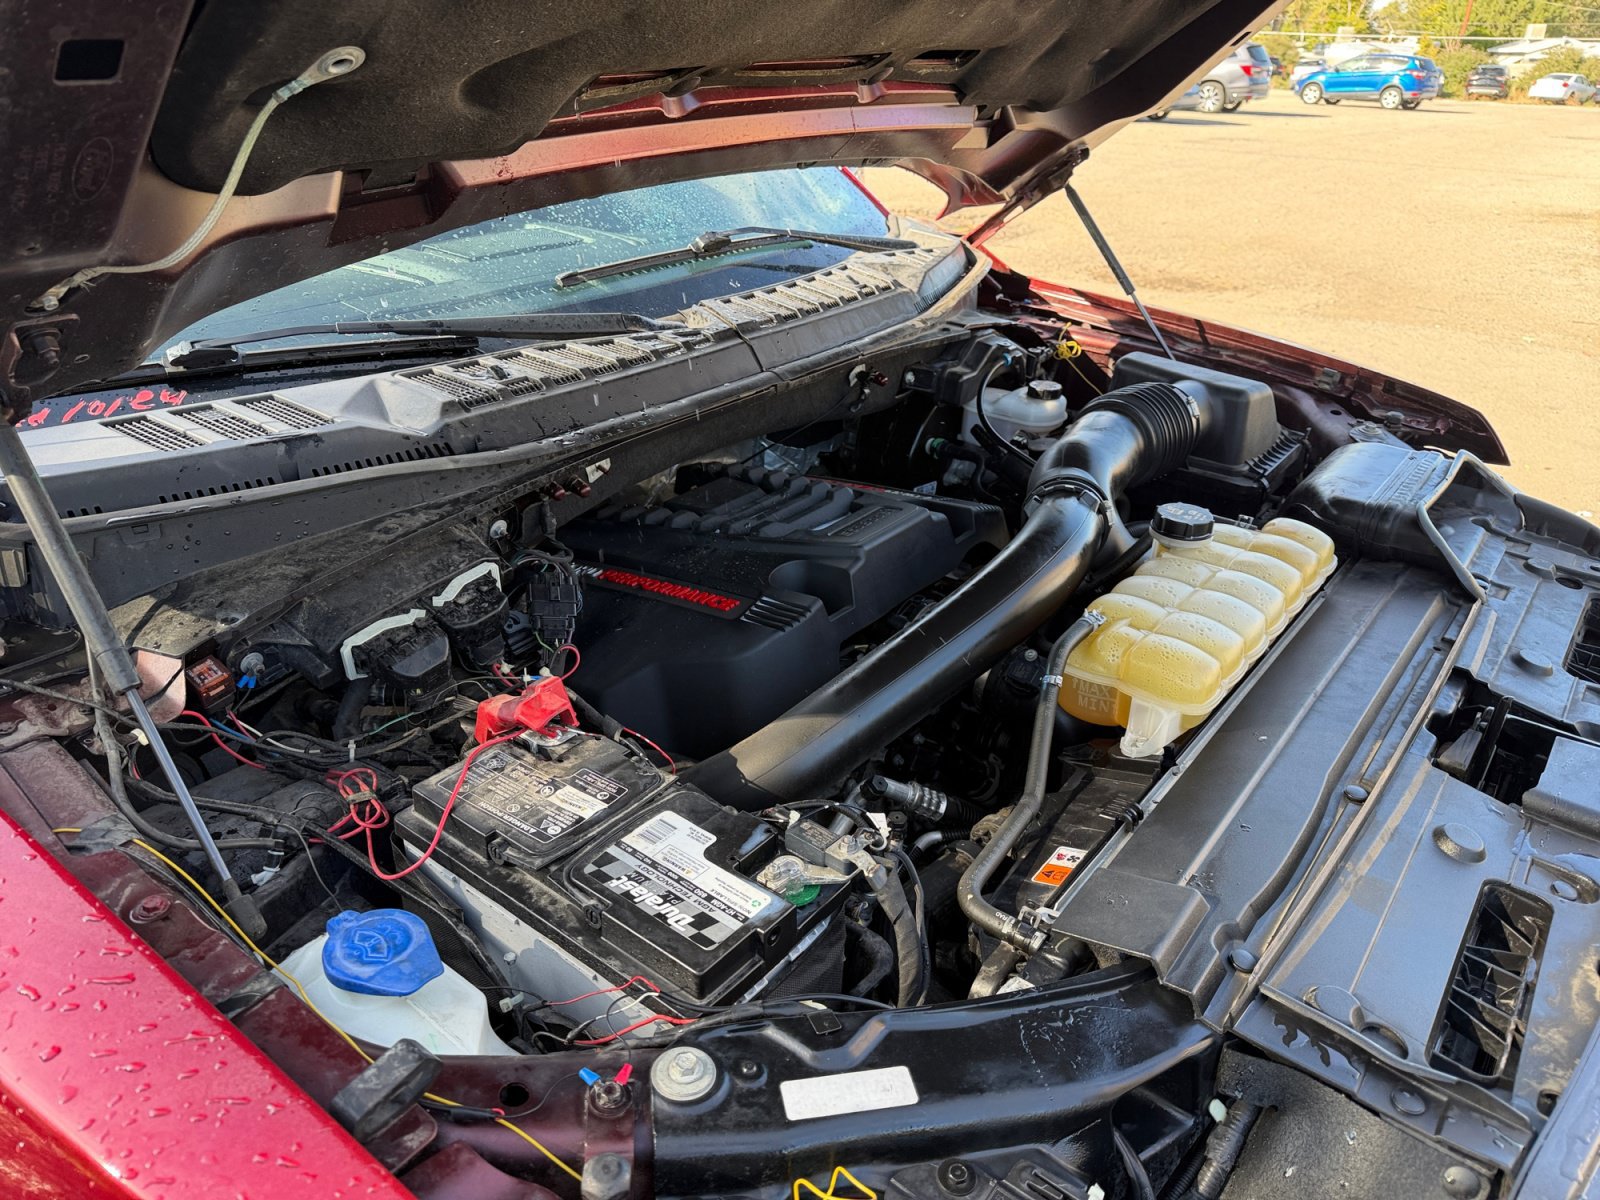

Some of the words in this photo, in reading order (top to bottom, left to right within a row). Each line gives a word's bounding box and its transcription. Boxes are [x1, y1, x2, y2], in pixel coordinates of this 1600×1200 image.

[598, 569, 741, 611] PERFORMANCE
[1078, 694, 1110, 713] MIN
[1079, 680, 1110, 697] MAX
[625, 870, 681, 905] PLATINUM
[634, 862, 693, 900] TECHNOLOGY
[608, 874, 695, 931] Duralast
[692, 898, 716, 913] AGM
